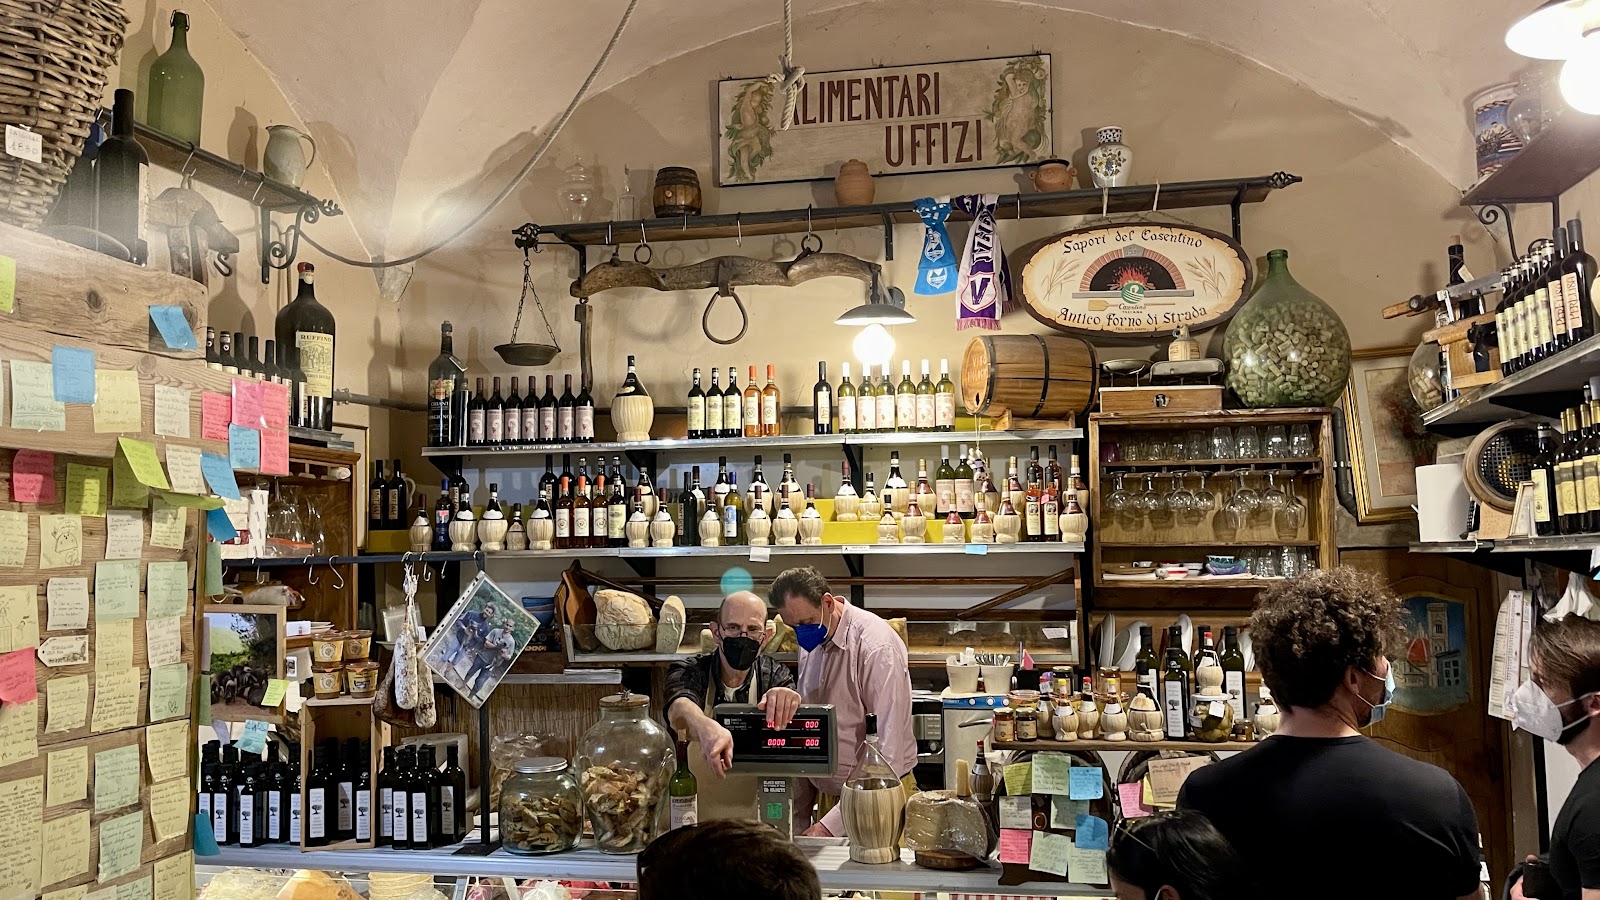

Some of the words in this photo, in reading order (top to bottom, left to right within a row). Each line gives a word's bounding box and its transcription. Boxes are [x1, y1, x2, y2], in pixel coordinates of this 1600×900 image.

[789, 72, 941, 126] LIMENTARI
[885, 119, 983, 168] UFFIZI
[1062, 233, 1107, 255] Sapori
[1114, 230, 1135, 243] del
[1141, 228, 1203, 249] Casentino
[1057, 307, 1102, 326] Antico
[1106, 311, 1142, 328] Forno
[1146, 313, 1158, 326] di
[1162, 306, 1208, 325] Strada
[300, 334, 332, 343] RUFFINO
